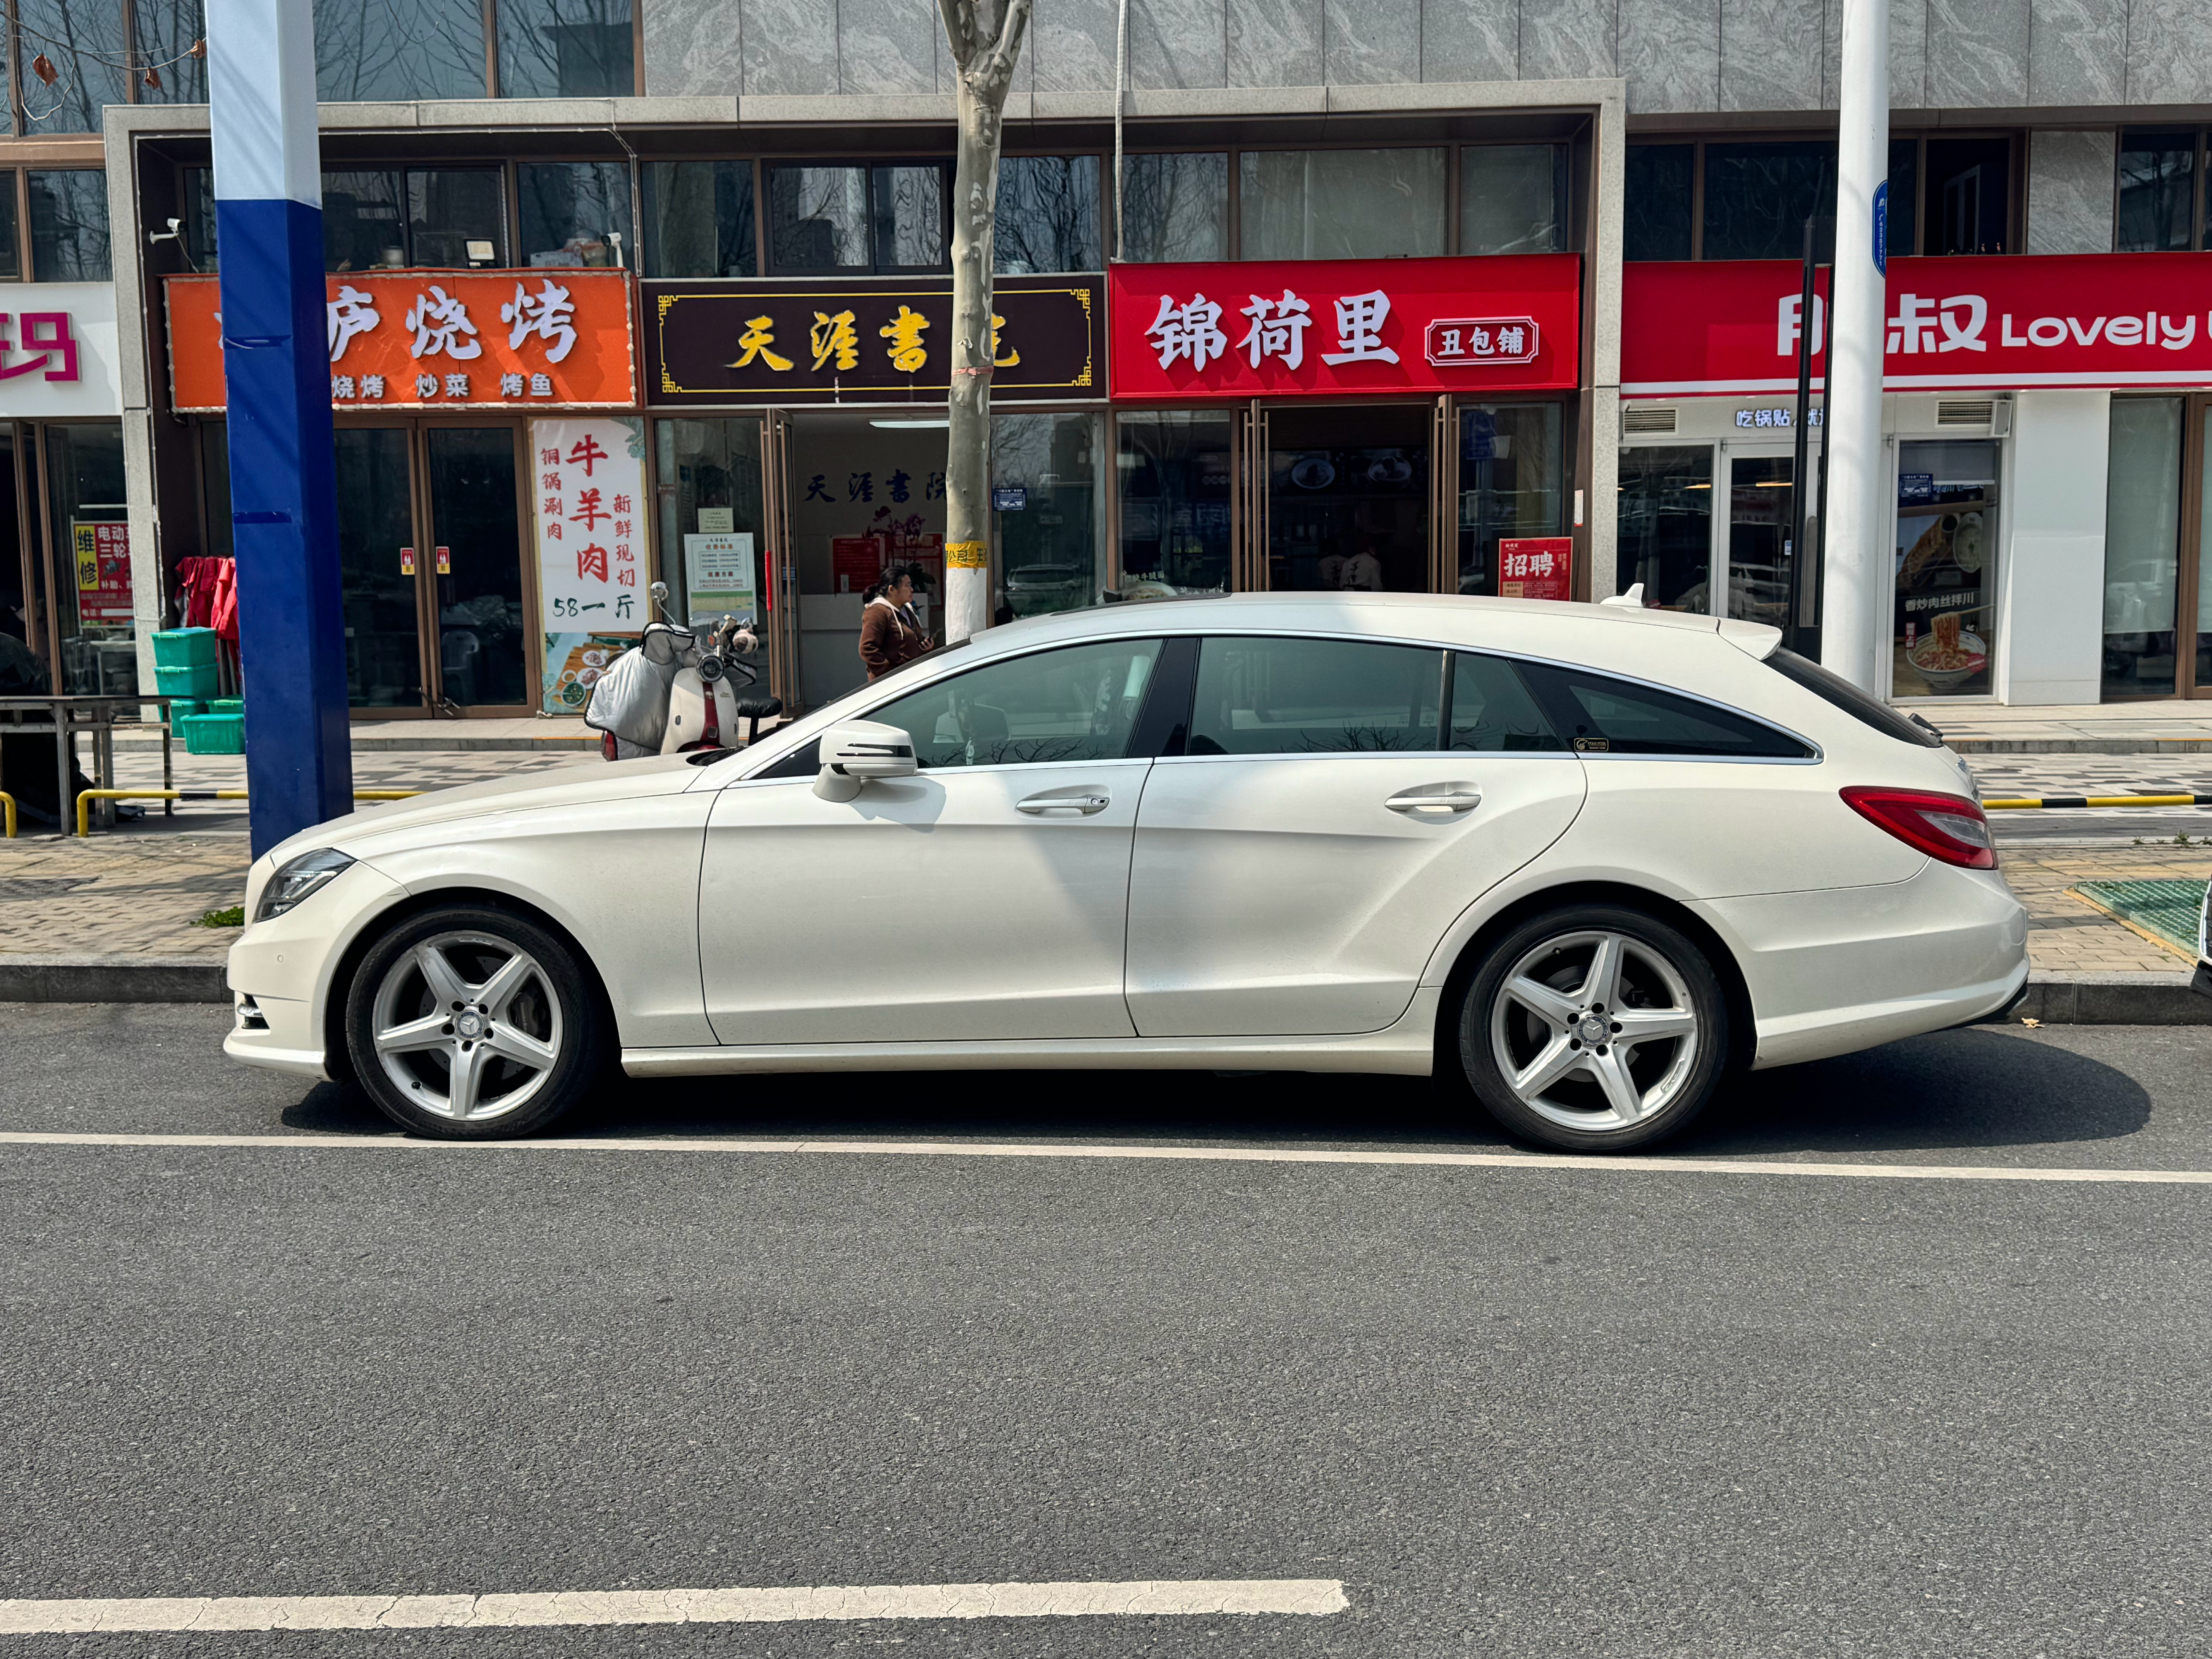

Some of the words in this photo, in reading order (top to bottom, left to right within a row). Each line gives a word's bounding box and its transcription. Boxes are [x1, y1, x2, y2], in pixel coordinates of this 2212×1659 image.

[1144, 289, 1400, 372] 锦荷里
[1437, 325, 1524, 357] 丑包铺
[2001, 311, 2196, 350] Lovely
[332, 374, 385, 399] 烧烤
[415, 373, 469, 398] 炒菜
[500, 373, 553, 397] 烤鱼
[541, 448, 563, 541] 铜锅涮肉
[566, 434, 612, 583] 牛羊肉
[77, 529, 97, 584] 维修
[613, 494, 635, 588] 新鲜现切
[1503, 550, 1554, 577] 招聘
[553, 594, 635, 619] 58一斤
